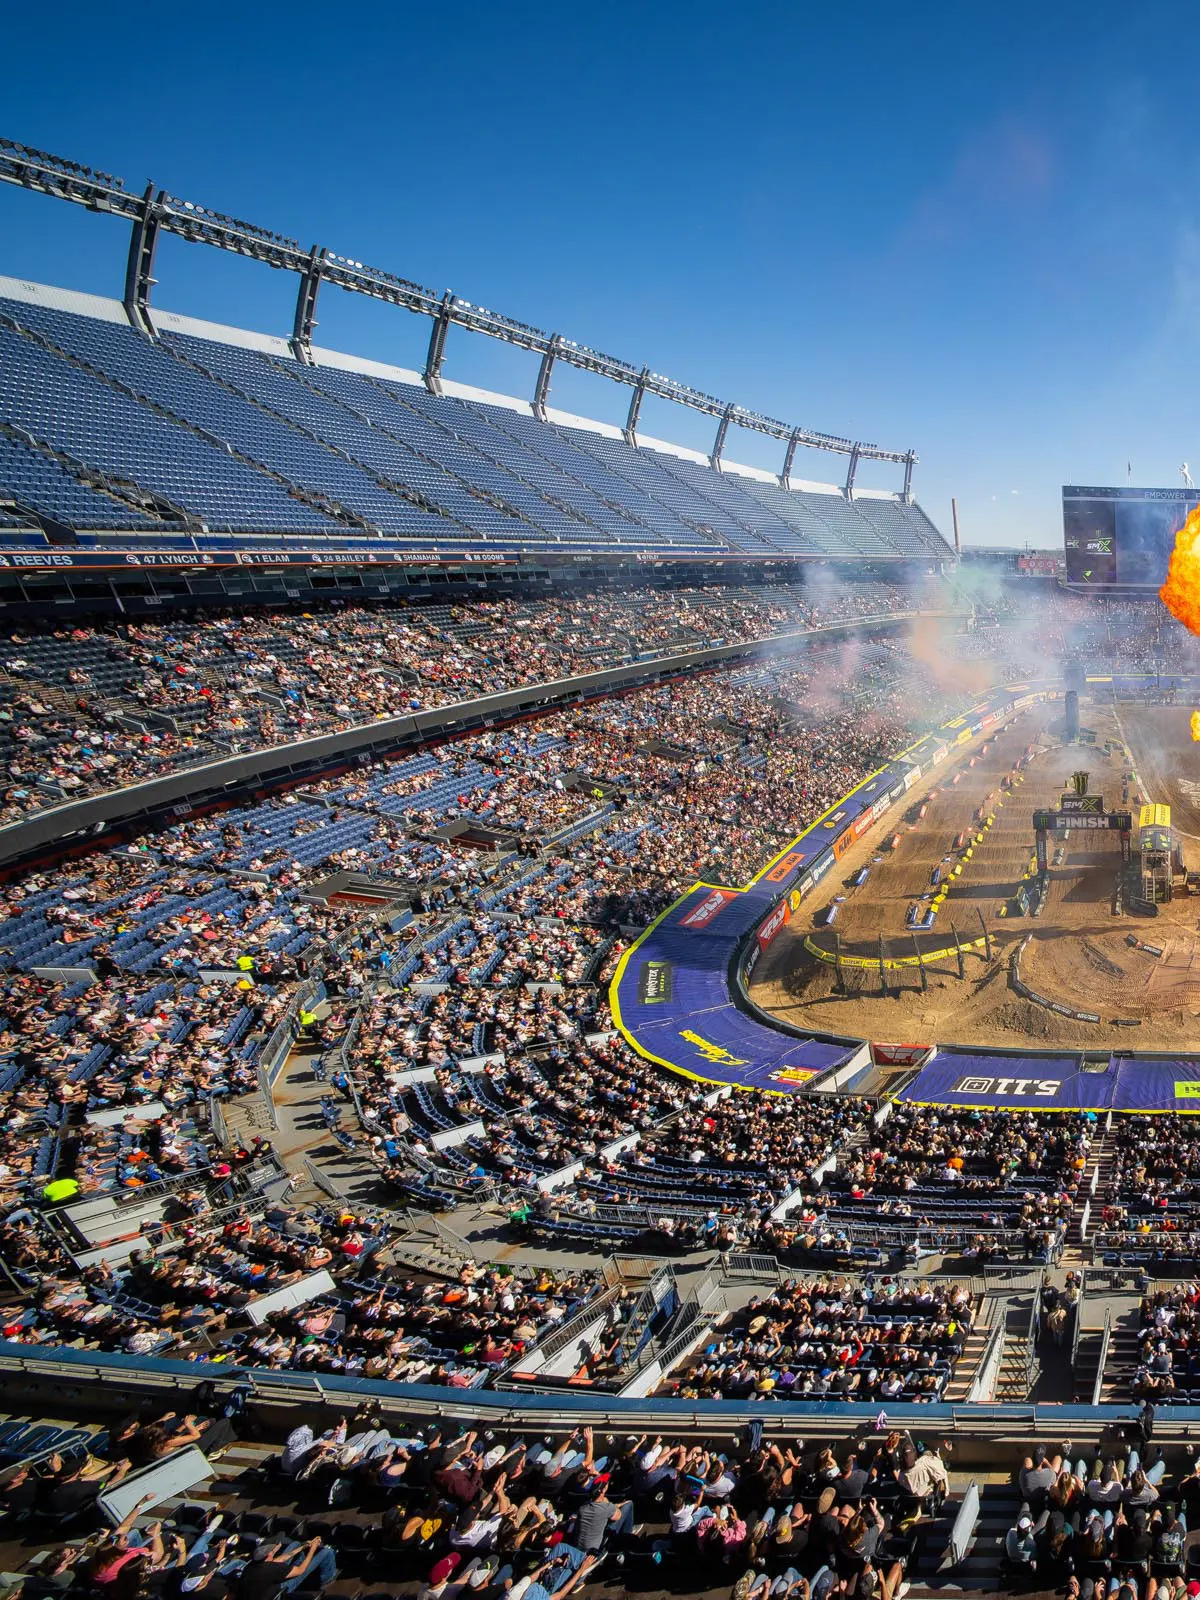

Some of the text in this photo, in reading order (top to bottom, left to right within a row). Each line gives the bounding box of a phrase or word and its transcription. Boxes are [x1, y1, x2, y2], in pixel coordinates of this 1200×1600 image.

[1144, 491, 1186, 499] EMPOWER
[13, 555, 73, 566] REEVES
[143, 554, 198, 564] 47 LYNCH
[262, 554, 290, 562] ELAM
[323, 554, 366, 562] 24 BAILEY
[1063, 798, 1099, 812] SMX
[1056, 816, 1109, 828] FINISH
[646, 968, 659, 997] MONSTER
[996, 1077, 1061, 1096] 5.11
